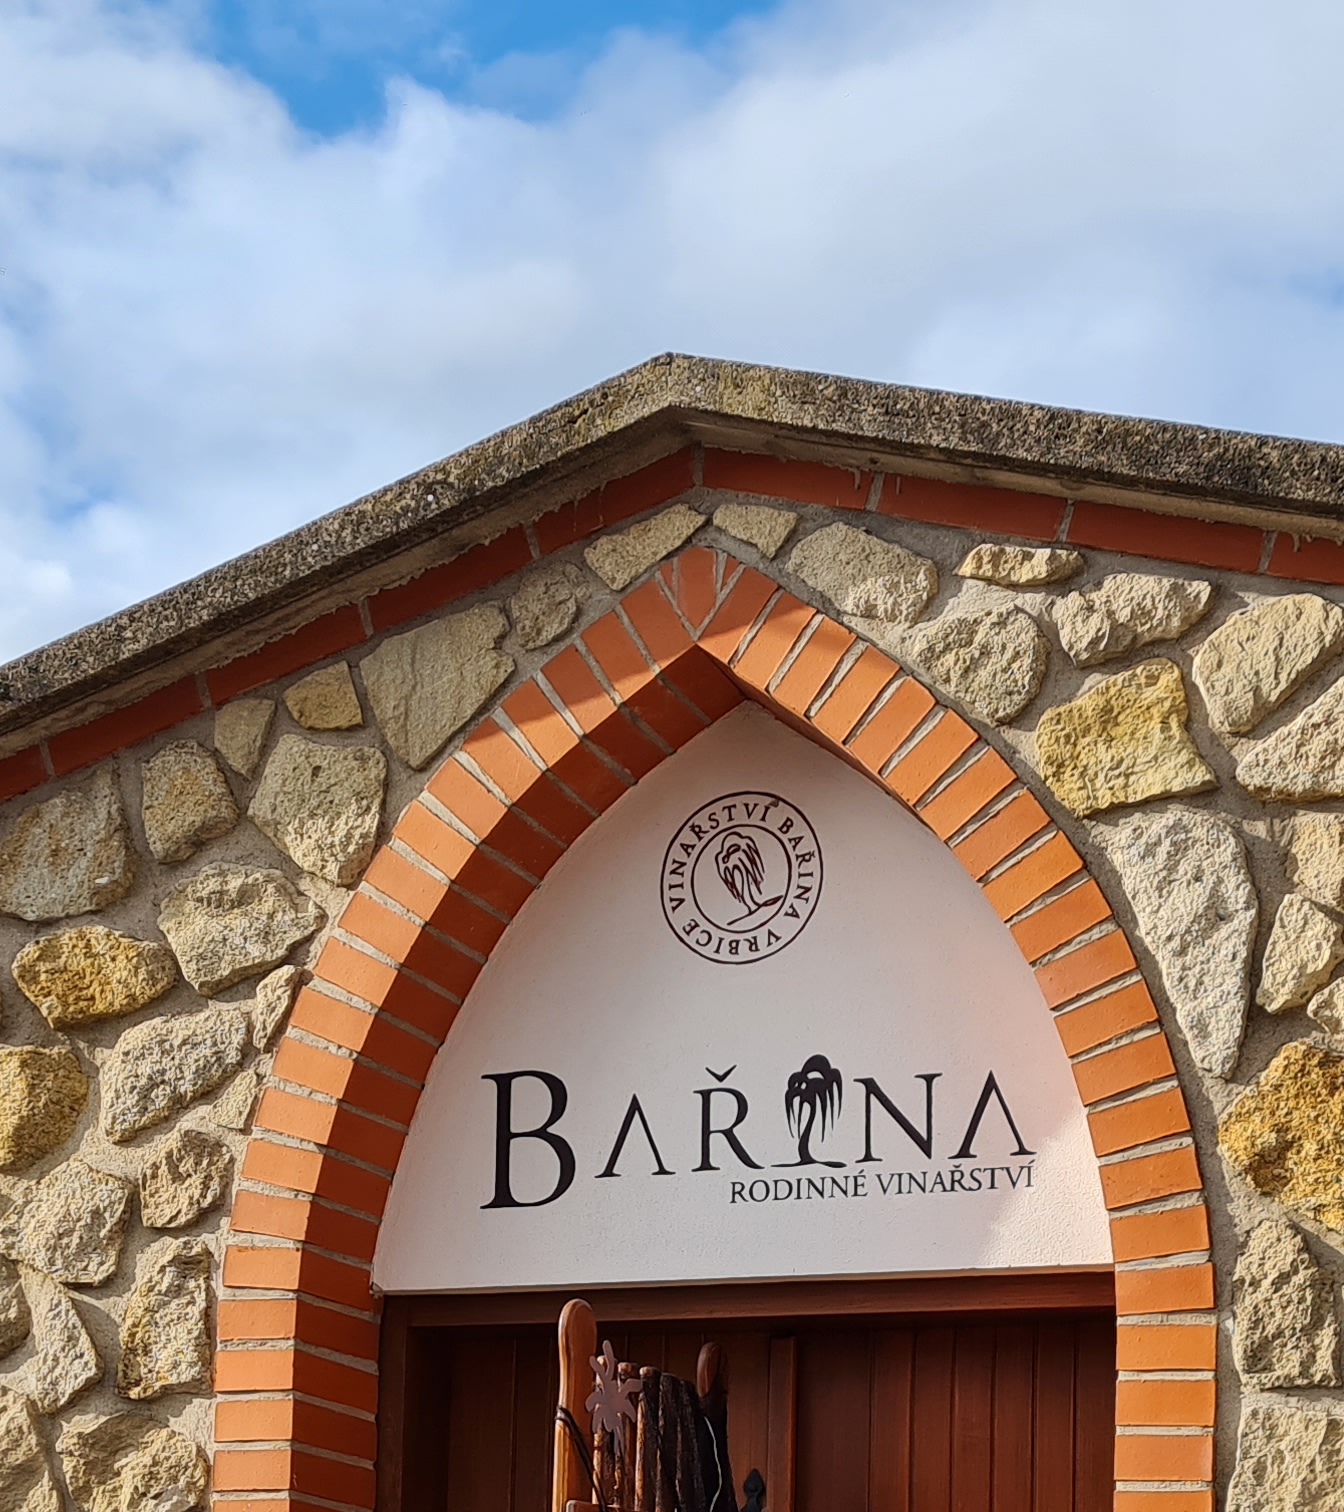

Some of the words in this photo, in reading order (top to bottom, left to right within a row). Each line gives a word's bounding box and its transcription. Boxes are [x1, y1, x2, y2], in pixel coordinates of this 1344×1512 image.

[669, 801, 779, 913] VINAŘSTVÍ
[778, 817, 816, 919] BAŘINA
[682, 918, 782, 955] VRBICE
[729, 1171, 868, 1204] RODINNÉ
[875, 1160, 1035, 1196] VINAŘSTVÍ
